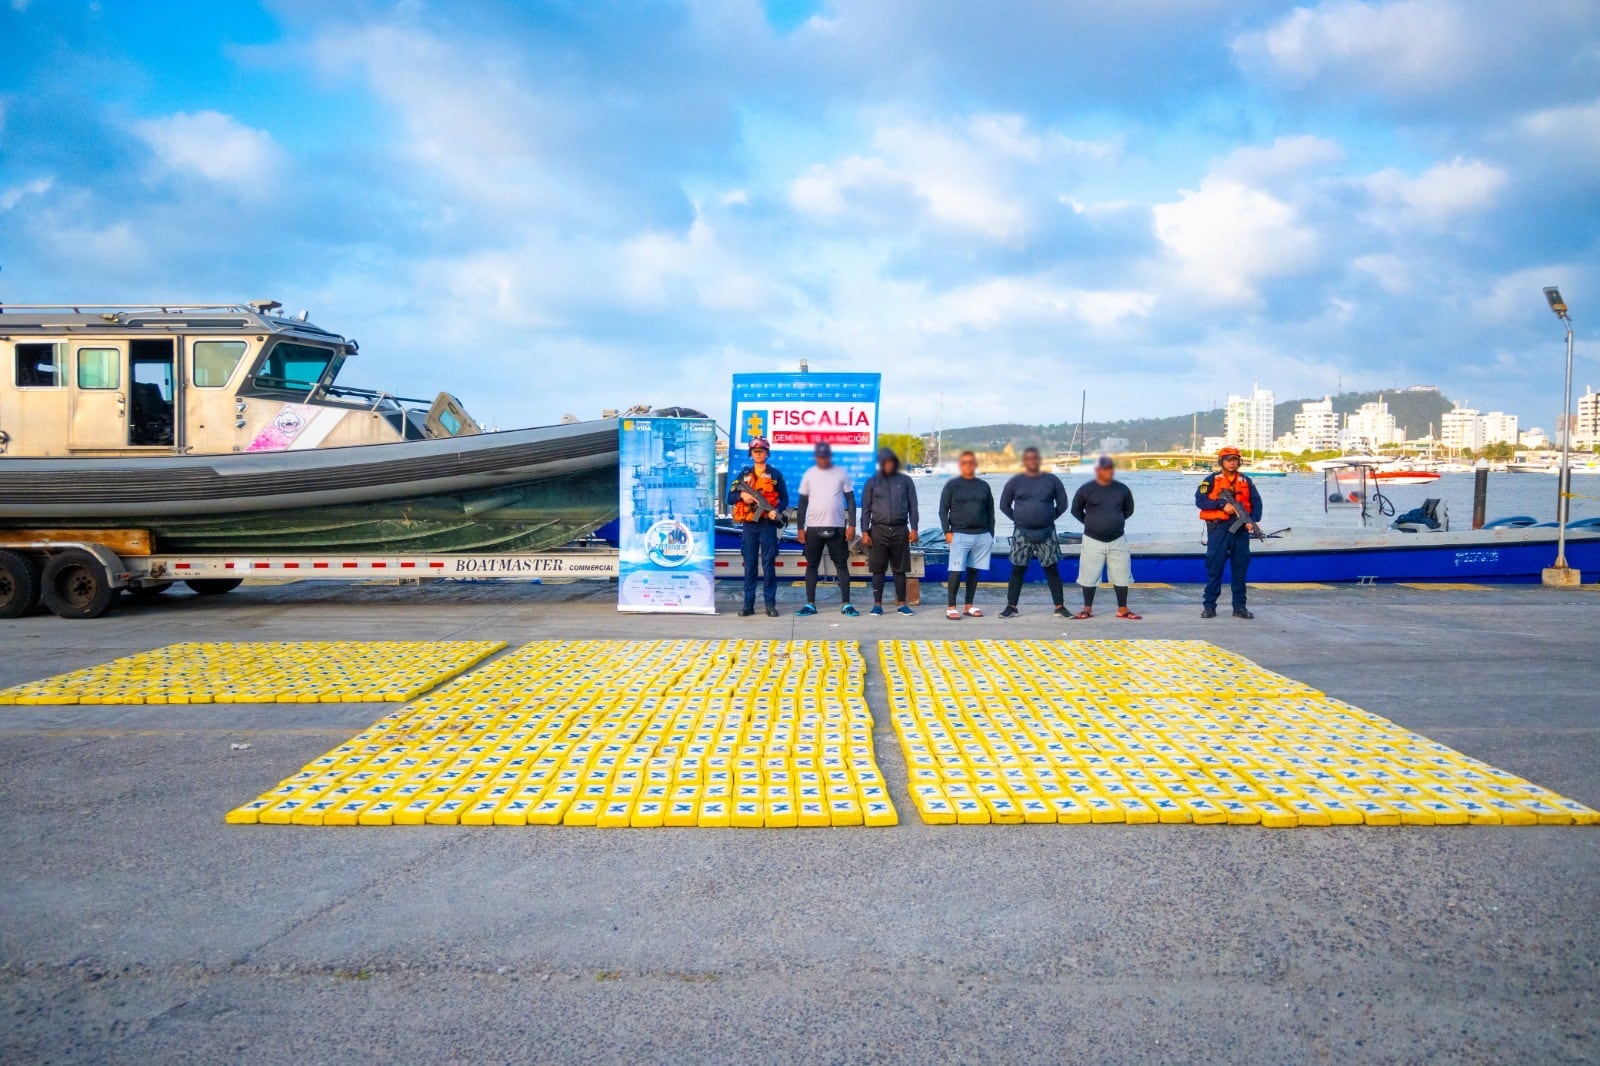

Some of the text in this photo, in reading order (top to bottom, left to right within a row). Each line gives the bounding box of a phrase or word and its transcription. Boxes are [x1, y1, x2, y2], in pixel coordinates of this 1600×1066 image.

[773, 407, 870, 426] FISCALÍA
[774, 434, 807, 442] GENERAL
[456, 559, 563, 572] BOATMASTER
